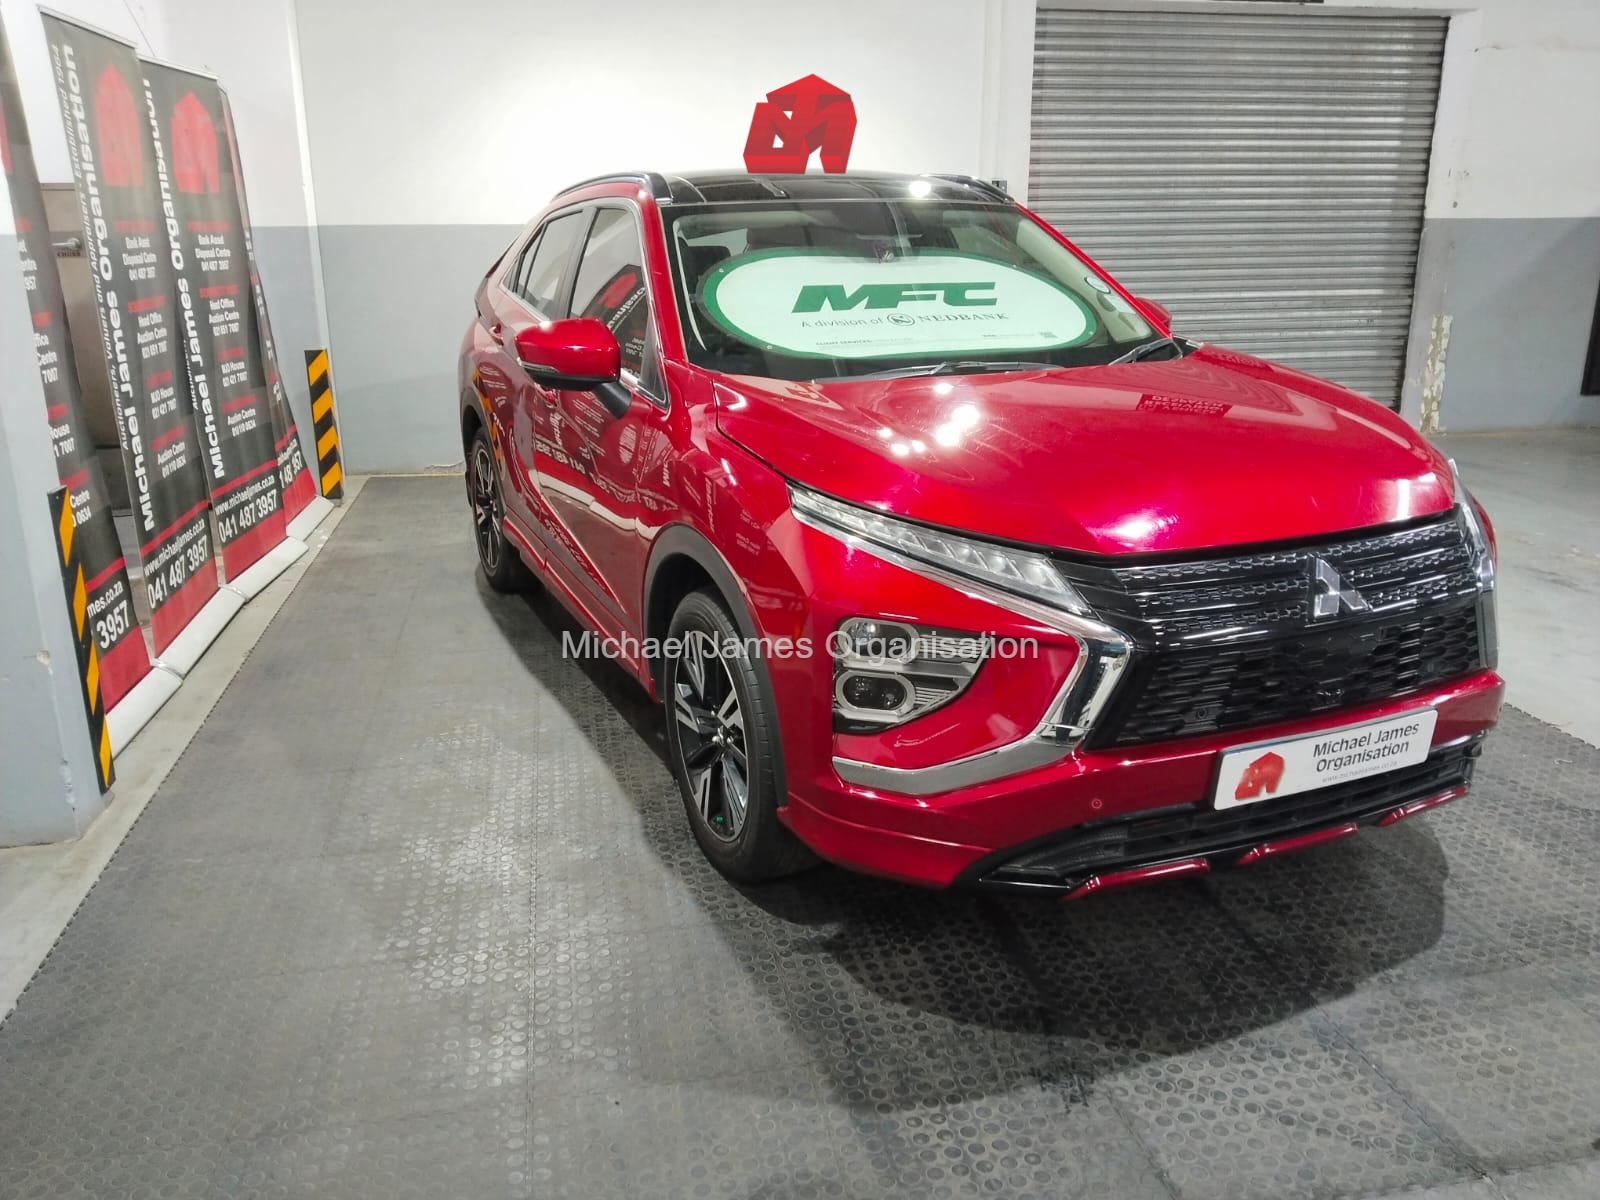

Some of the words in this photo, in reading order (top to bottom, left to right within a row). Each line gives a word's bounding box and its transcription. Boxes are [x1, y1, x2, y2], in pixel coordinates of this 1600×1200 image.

[51, 44, 65, 84] 1964
[60, 87, 82, 179] Established
[63, 44, 113, 281] Organisation
[80, 191, 98, 271] Appraisers
[92, 273, 104, 304] and
[791, 282, 996, 312] MFC
[99, 307, 114, 360] Valuers
[106, 290, 133, 398] James
[177, 278, 204, 367] James
[814, 318, 868, 328] division
[870, 316, 883, 326] of
[918, 312, 1009, 322] NEDBANK
[59, 438, 76, 456] 7007
[194, 374, 225, 479] Michael
[124, 405, 156, 532] Michael
[70, 488, 91, 510] Centre
[218, 515, 237, 545] 041
[238, 500, 258, 529] 487
[256, 488, 278, 518] 3957
[147, 563, 168, 610] 041
[168, 552, 186, 589] 487
[186, 536, 209, 571] 3957
[97, 600, 131, 650] 3957
[1313, 732, 1371, 758] Michael
[1374, 722, 1420, 745] James
[1316, 740, 1409, 774] Organisation
